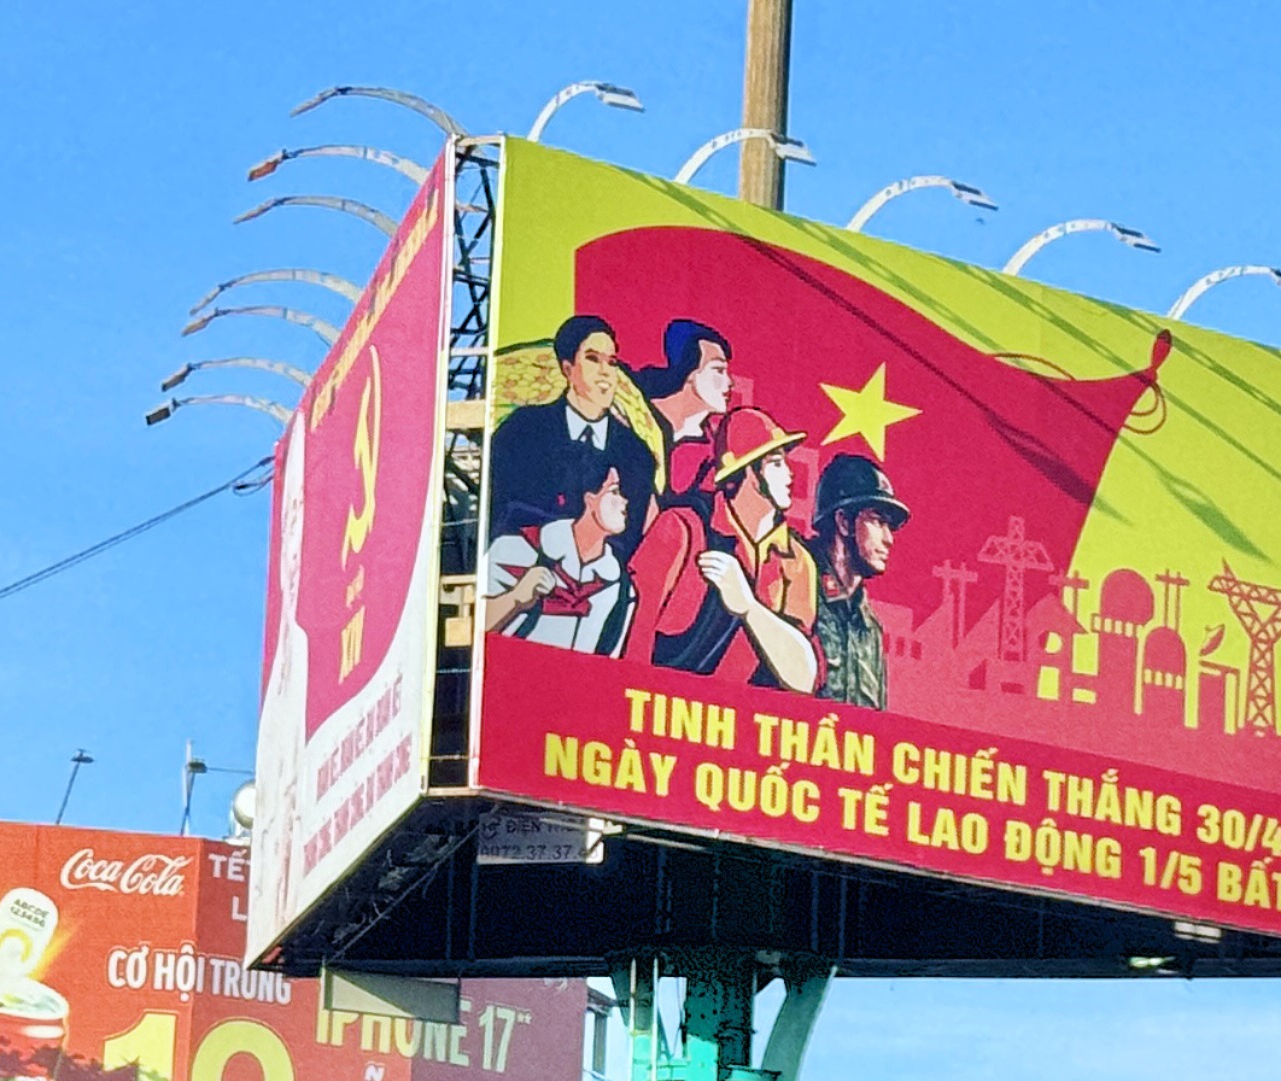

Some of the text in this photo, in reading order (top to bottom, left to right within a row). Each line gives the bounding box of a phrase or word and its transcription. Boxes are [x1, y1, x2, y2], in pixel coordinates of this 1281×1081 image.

[544, 732, 678, 798] NGÀY
[694, 762, 821, 823] QUỐC
[837, 782, 894, 837] TẾ
[906, 802, 989, 855] LAO
[1005, 819, 1122, 879] ĐỘNG
[1139, 848, 1202, 895] 1/5
[625, 688, 736, 750] TINH
[753, 712, 875, 776] THẦN
[892, 741, 1027, 805] CHIẾN
[1043, 768, 1182, 838] THẮNG
[208, 849, 250, 882] TẾ
[108, 944, 150, 989] CƠ
[153, 943, 206, 1002] HỘI
